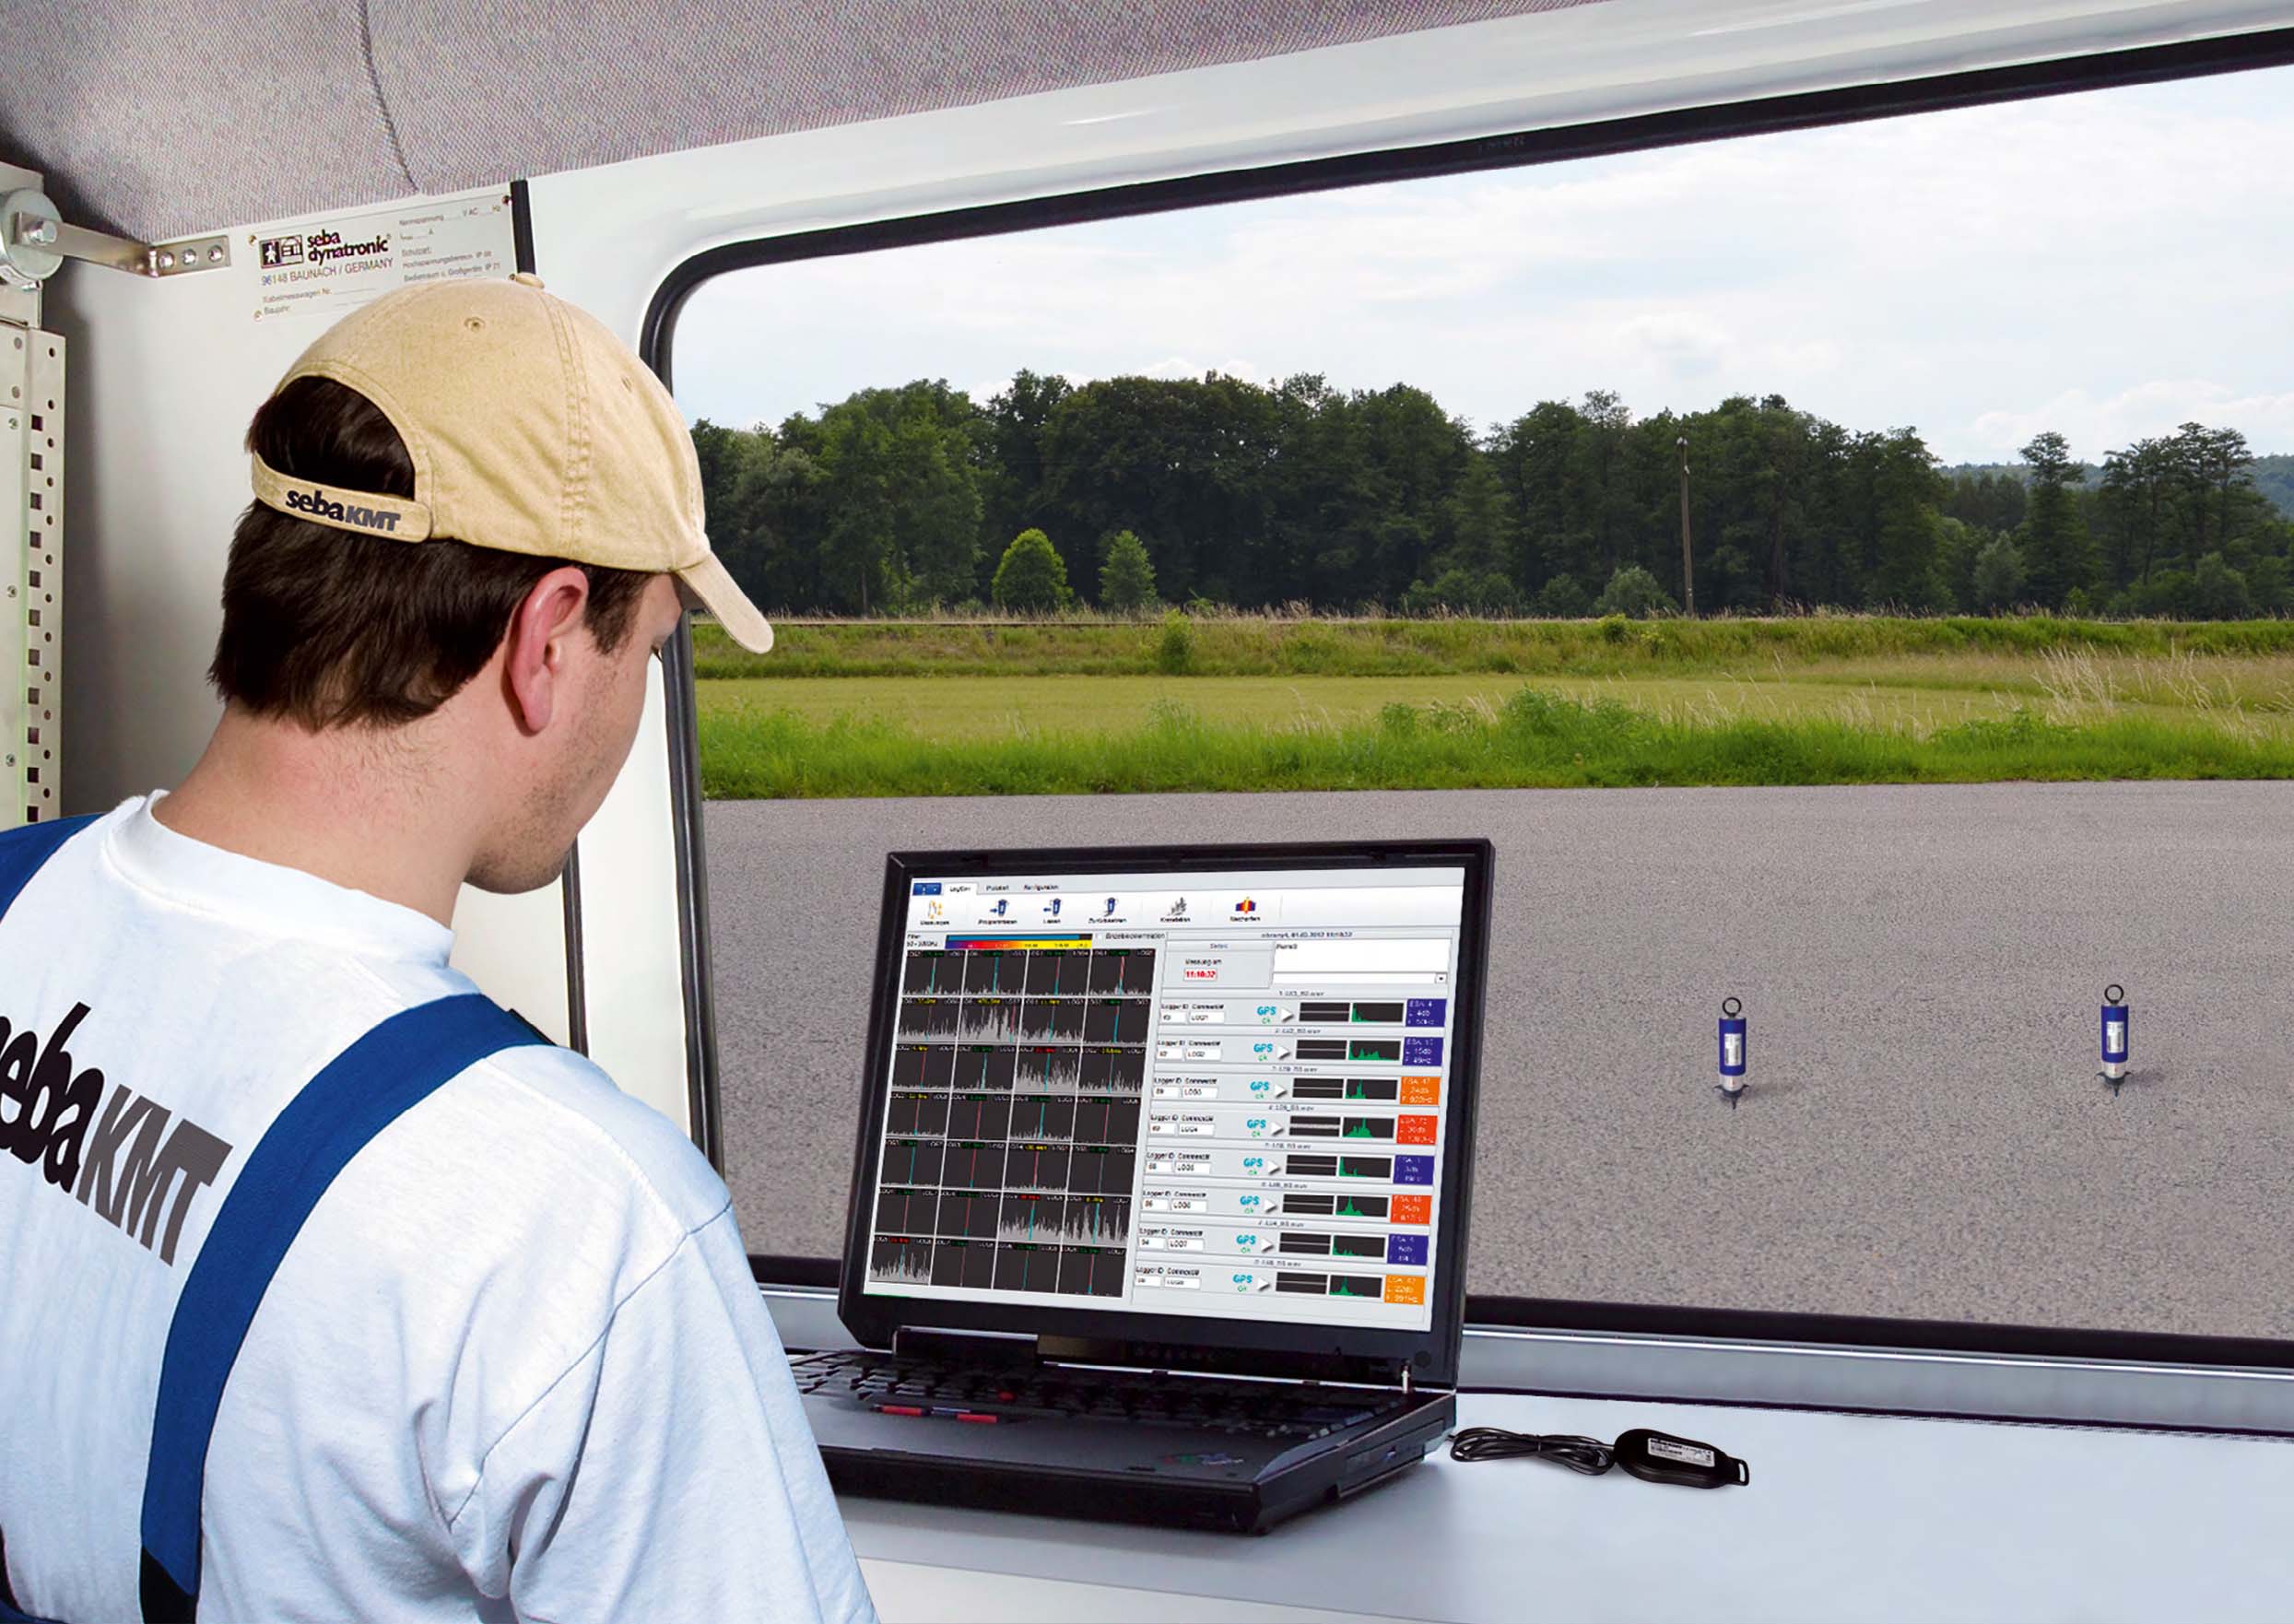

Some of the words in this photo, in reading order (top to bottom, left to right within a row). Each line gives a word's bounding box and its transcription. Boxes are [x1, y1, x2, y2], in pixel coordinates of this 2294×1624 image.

[307, 229, 341, 248] seba
[308, 235, 389, 265] dynatronic
[262, 275, 288, 286] 96148
[290, 266, 336, 283] BAUNACH
[345, 258, 394, 274] GERMANY
[286, 489, 401, 532] sebaKMT
[1257, 1006, 1276, 1016] GPS
[1253, 1043, 1273, 1053] GPS
[1250, 1081, 1269, 1091] GPS
[1247, 1119, 1266, 1129] GPS
[0, 1002, 233, 1267] ebaKMT
[1243, 1158, 1263, 1168] GPS
[1240, 1195, 1260, 1206] GPS
[1236, 1235, 1256, 1244] GPS
[1232, 1274, 1253, 1284] GPS
